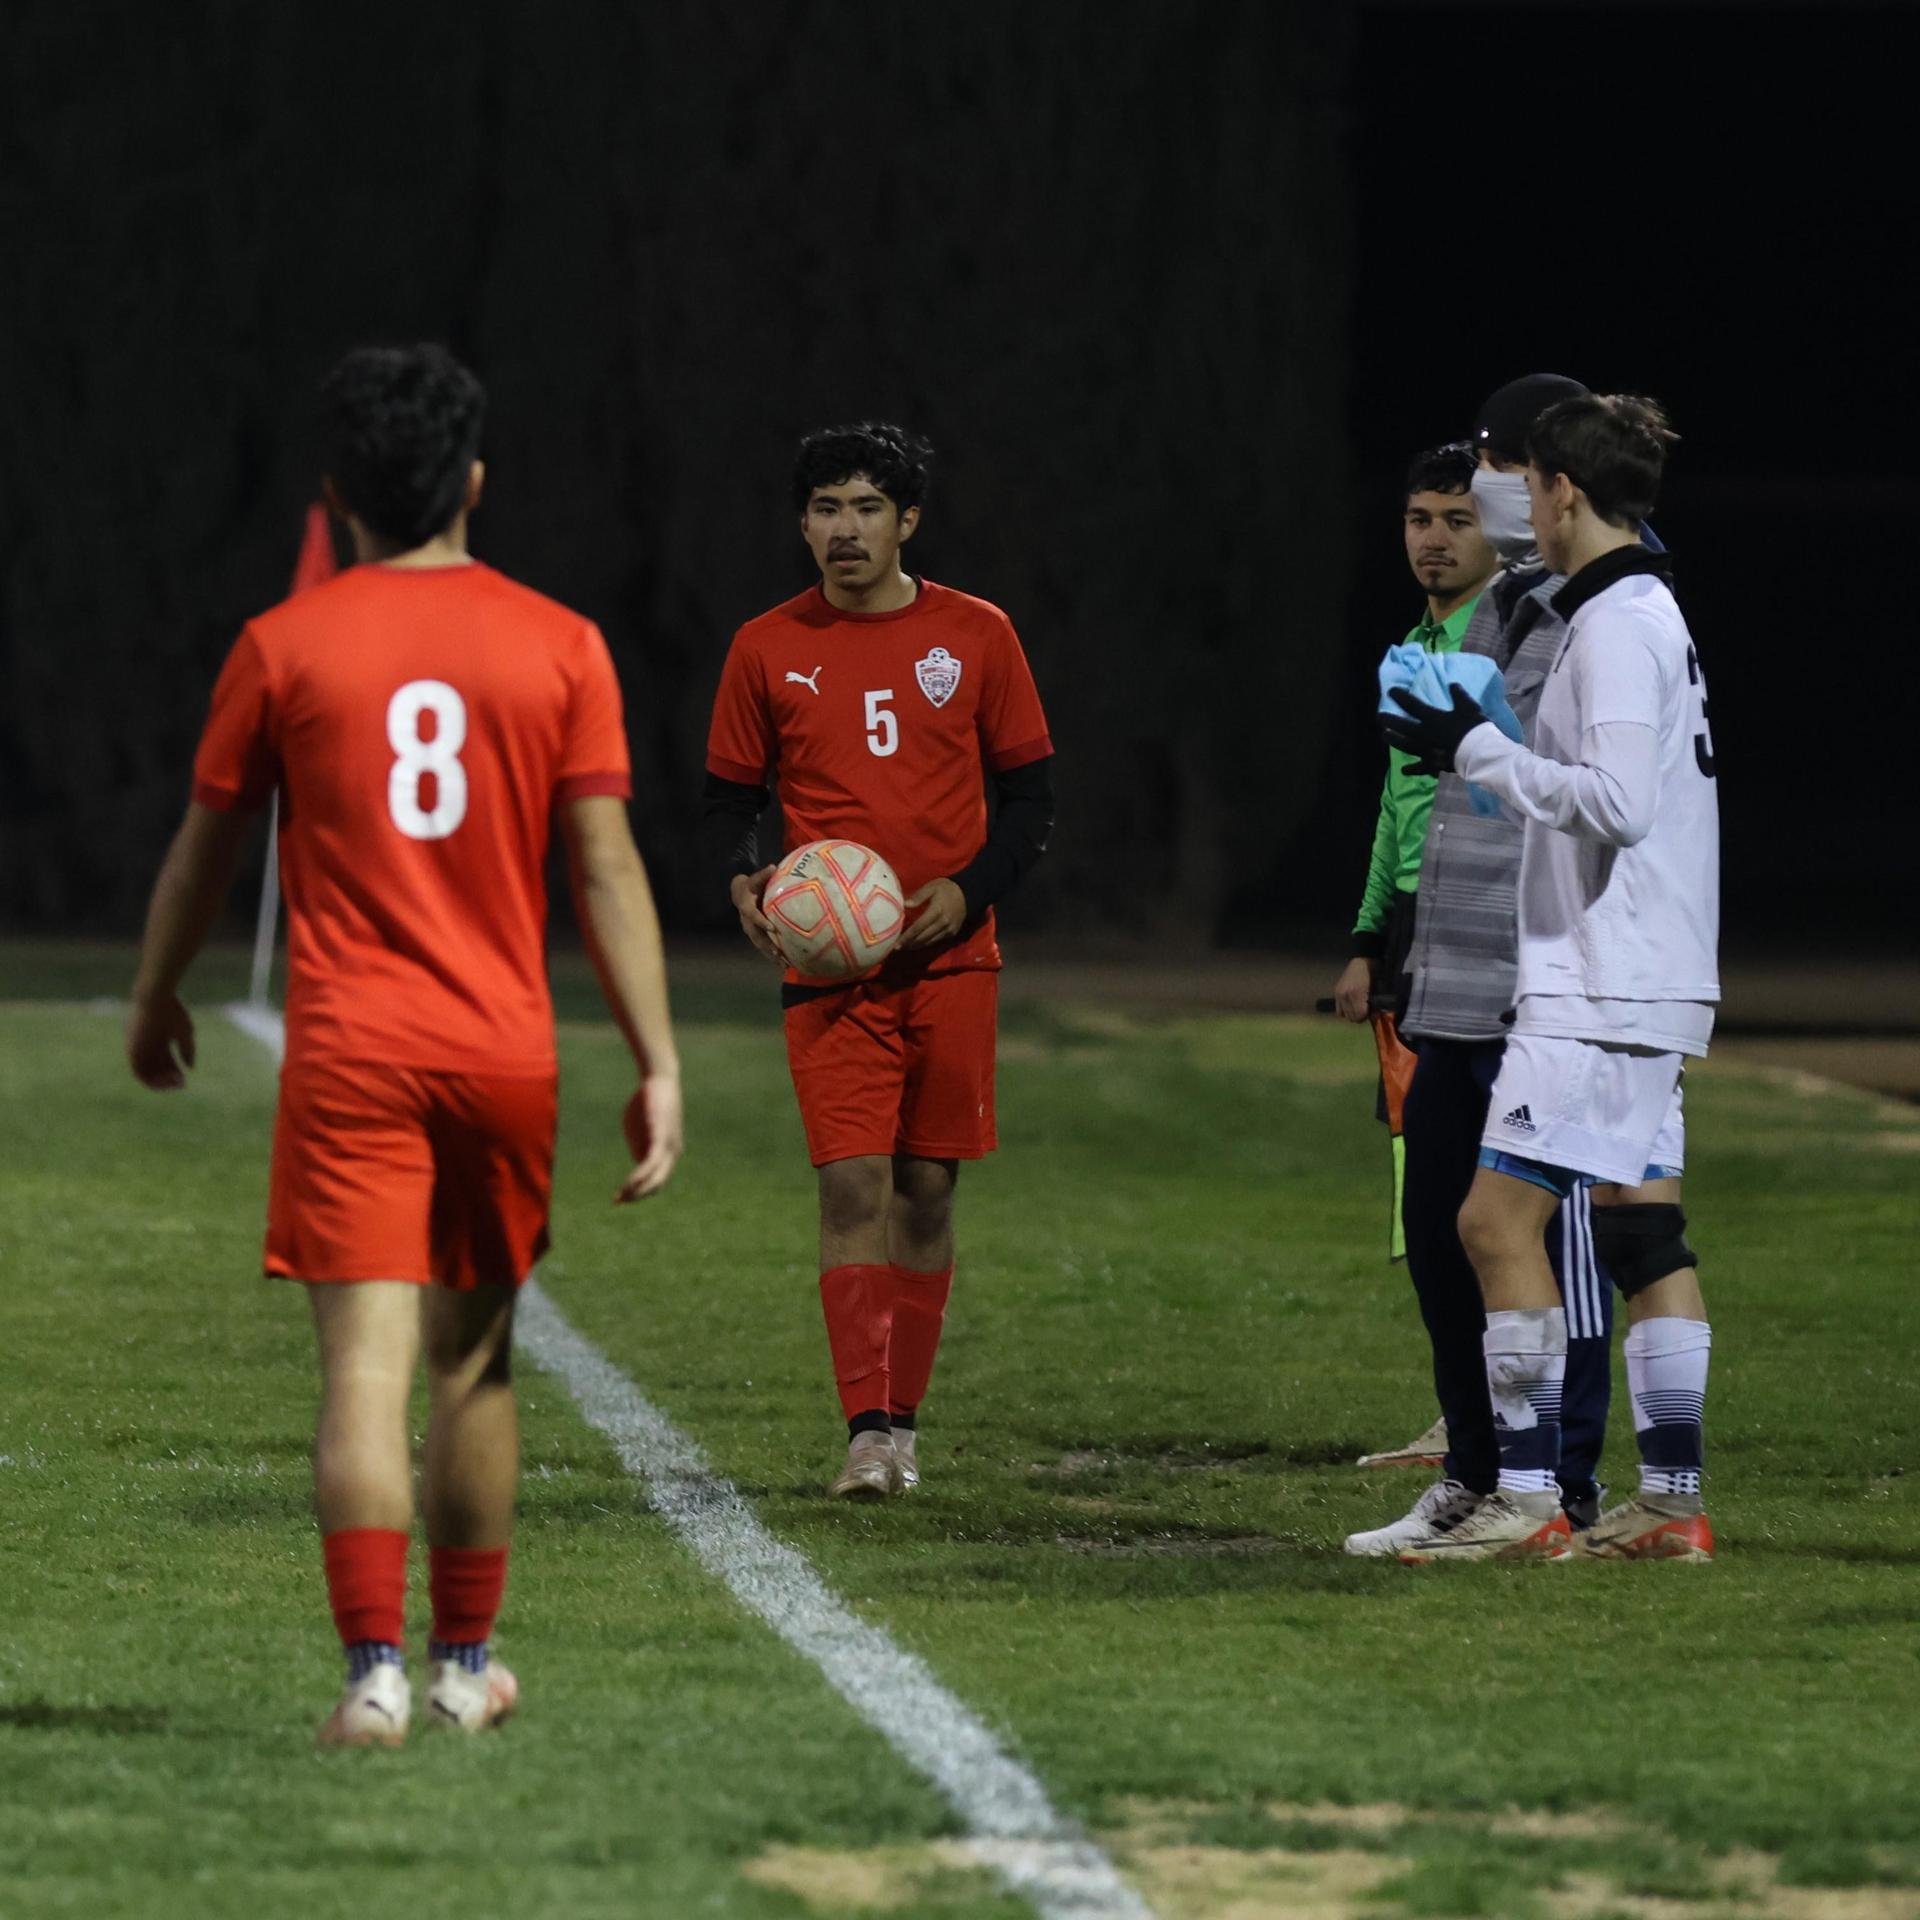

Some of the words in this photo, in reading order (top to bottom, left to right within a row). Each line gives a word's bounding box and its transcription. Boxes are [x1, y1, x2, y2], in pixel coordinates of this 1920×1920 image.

[864, 688, 899, 757] 5
[387, 679, 468, 840] 8
[1502, 1116, 1537, 1132] adidas
